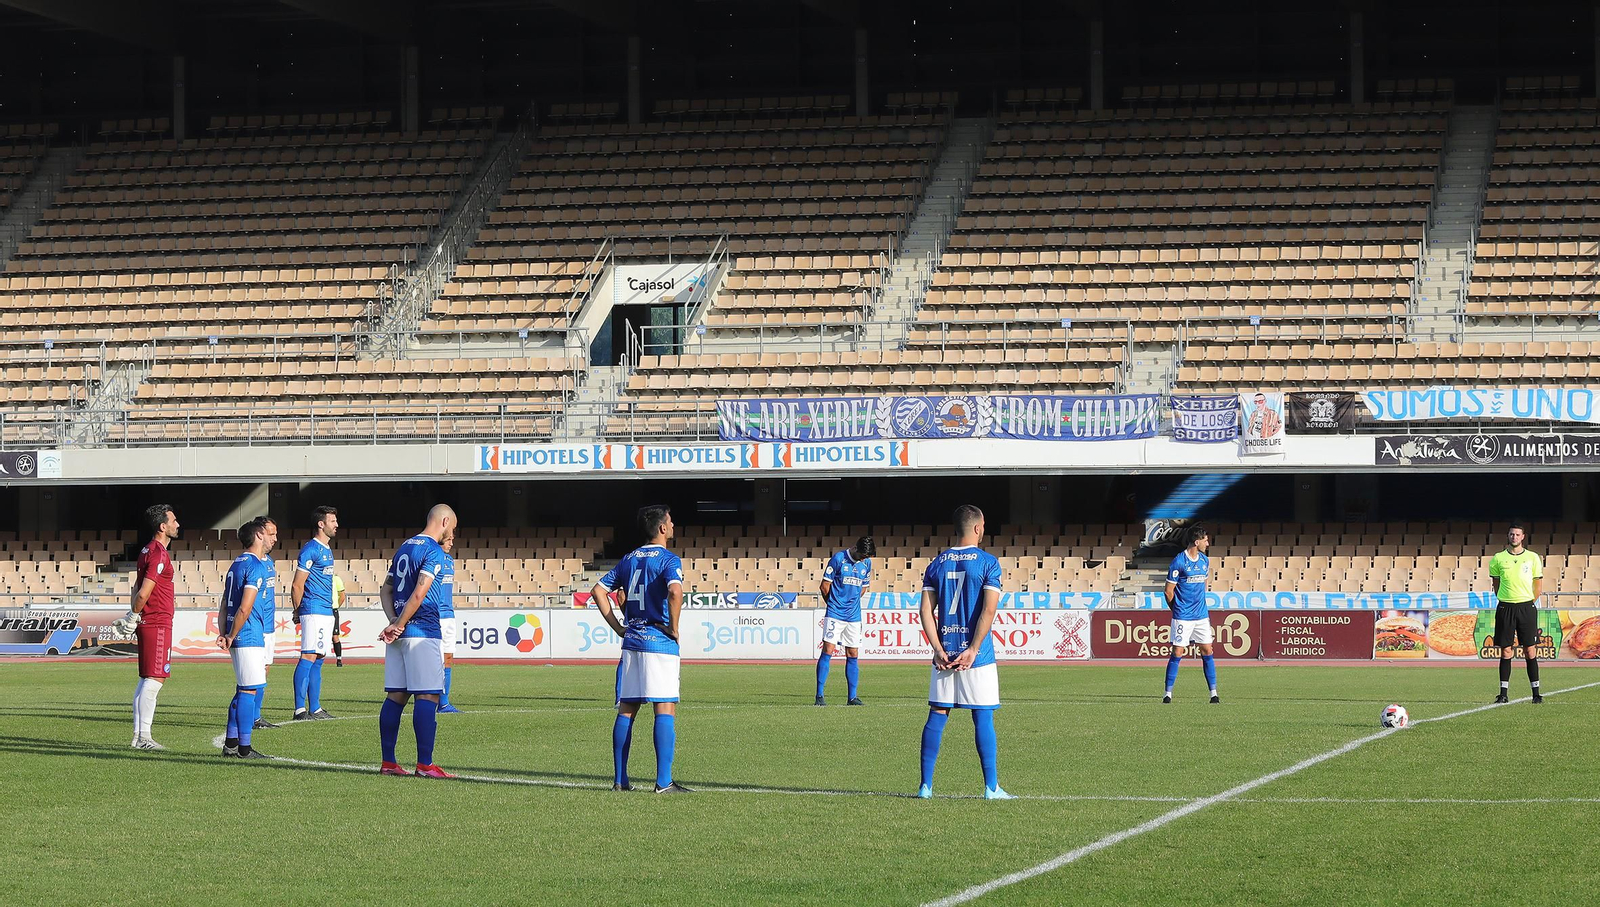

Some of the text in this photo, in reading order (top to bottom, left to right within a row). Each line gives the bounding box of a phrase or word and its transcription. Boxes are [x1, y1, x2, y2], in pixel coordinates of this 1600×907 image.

[629, 278, 675, 293] Cajasol
[1174, 399, 1236, 411] XEREZ
[1367, 389, 1487, 420] SOMOS
[1512, 388, 1593, 420] UNO
[718, 399, 875, 439] WE ARE XEREZ
[994, 396, 1159, 437] FROM CHAPIN
[1183, 414, 1224, 427] DE LOS
[1175, 428, 1235, 441] SOCIOS
[1245, 438, 1282, 447] CHOOSE LIFE
[503, 448, 590, 465] HIPOTELS
[647, 446, 736, 464] HIPOTELS
[795, 445, 886, 463] HIPOTELS
[1503, 443, 1600, 457] ALIMENTOS DE
[396, 554, 410, 592] 9
[627, 569, 645, 611] 4
[947, 570, 966, 616] 7
[866, 612, 903, 624] BAR
[1281, 617, 1351, 625] CONTABILIDAD
[828, 620, 836, 631] 3
[1177, 624, 1184, 635] 8
[1281, 627, 1315, 635] FISCAL
[318, 628, 324, 640] 5
[701, 622, 800, 652] Beiman
[1281, 637, 1327, 645] LABORAL
[1281, 648, 1326, 656] JURIDICO
